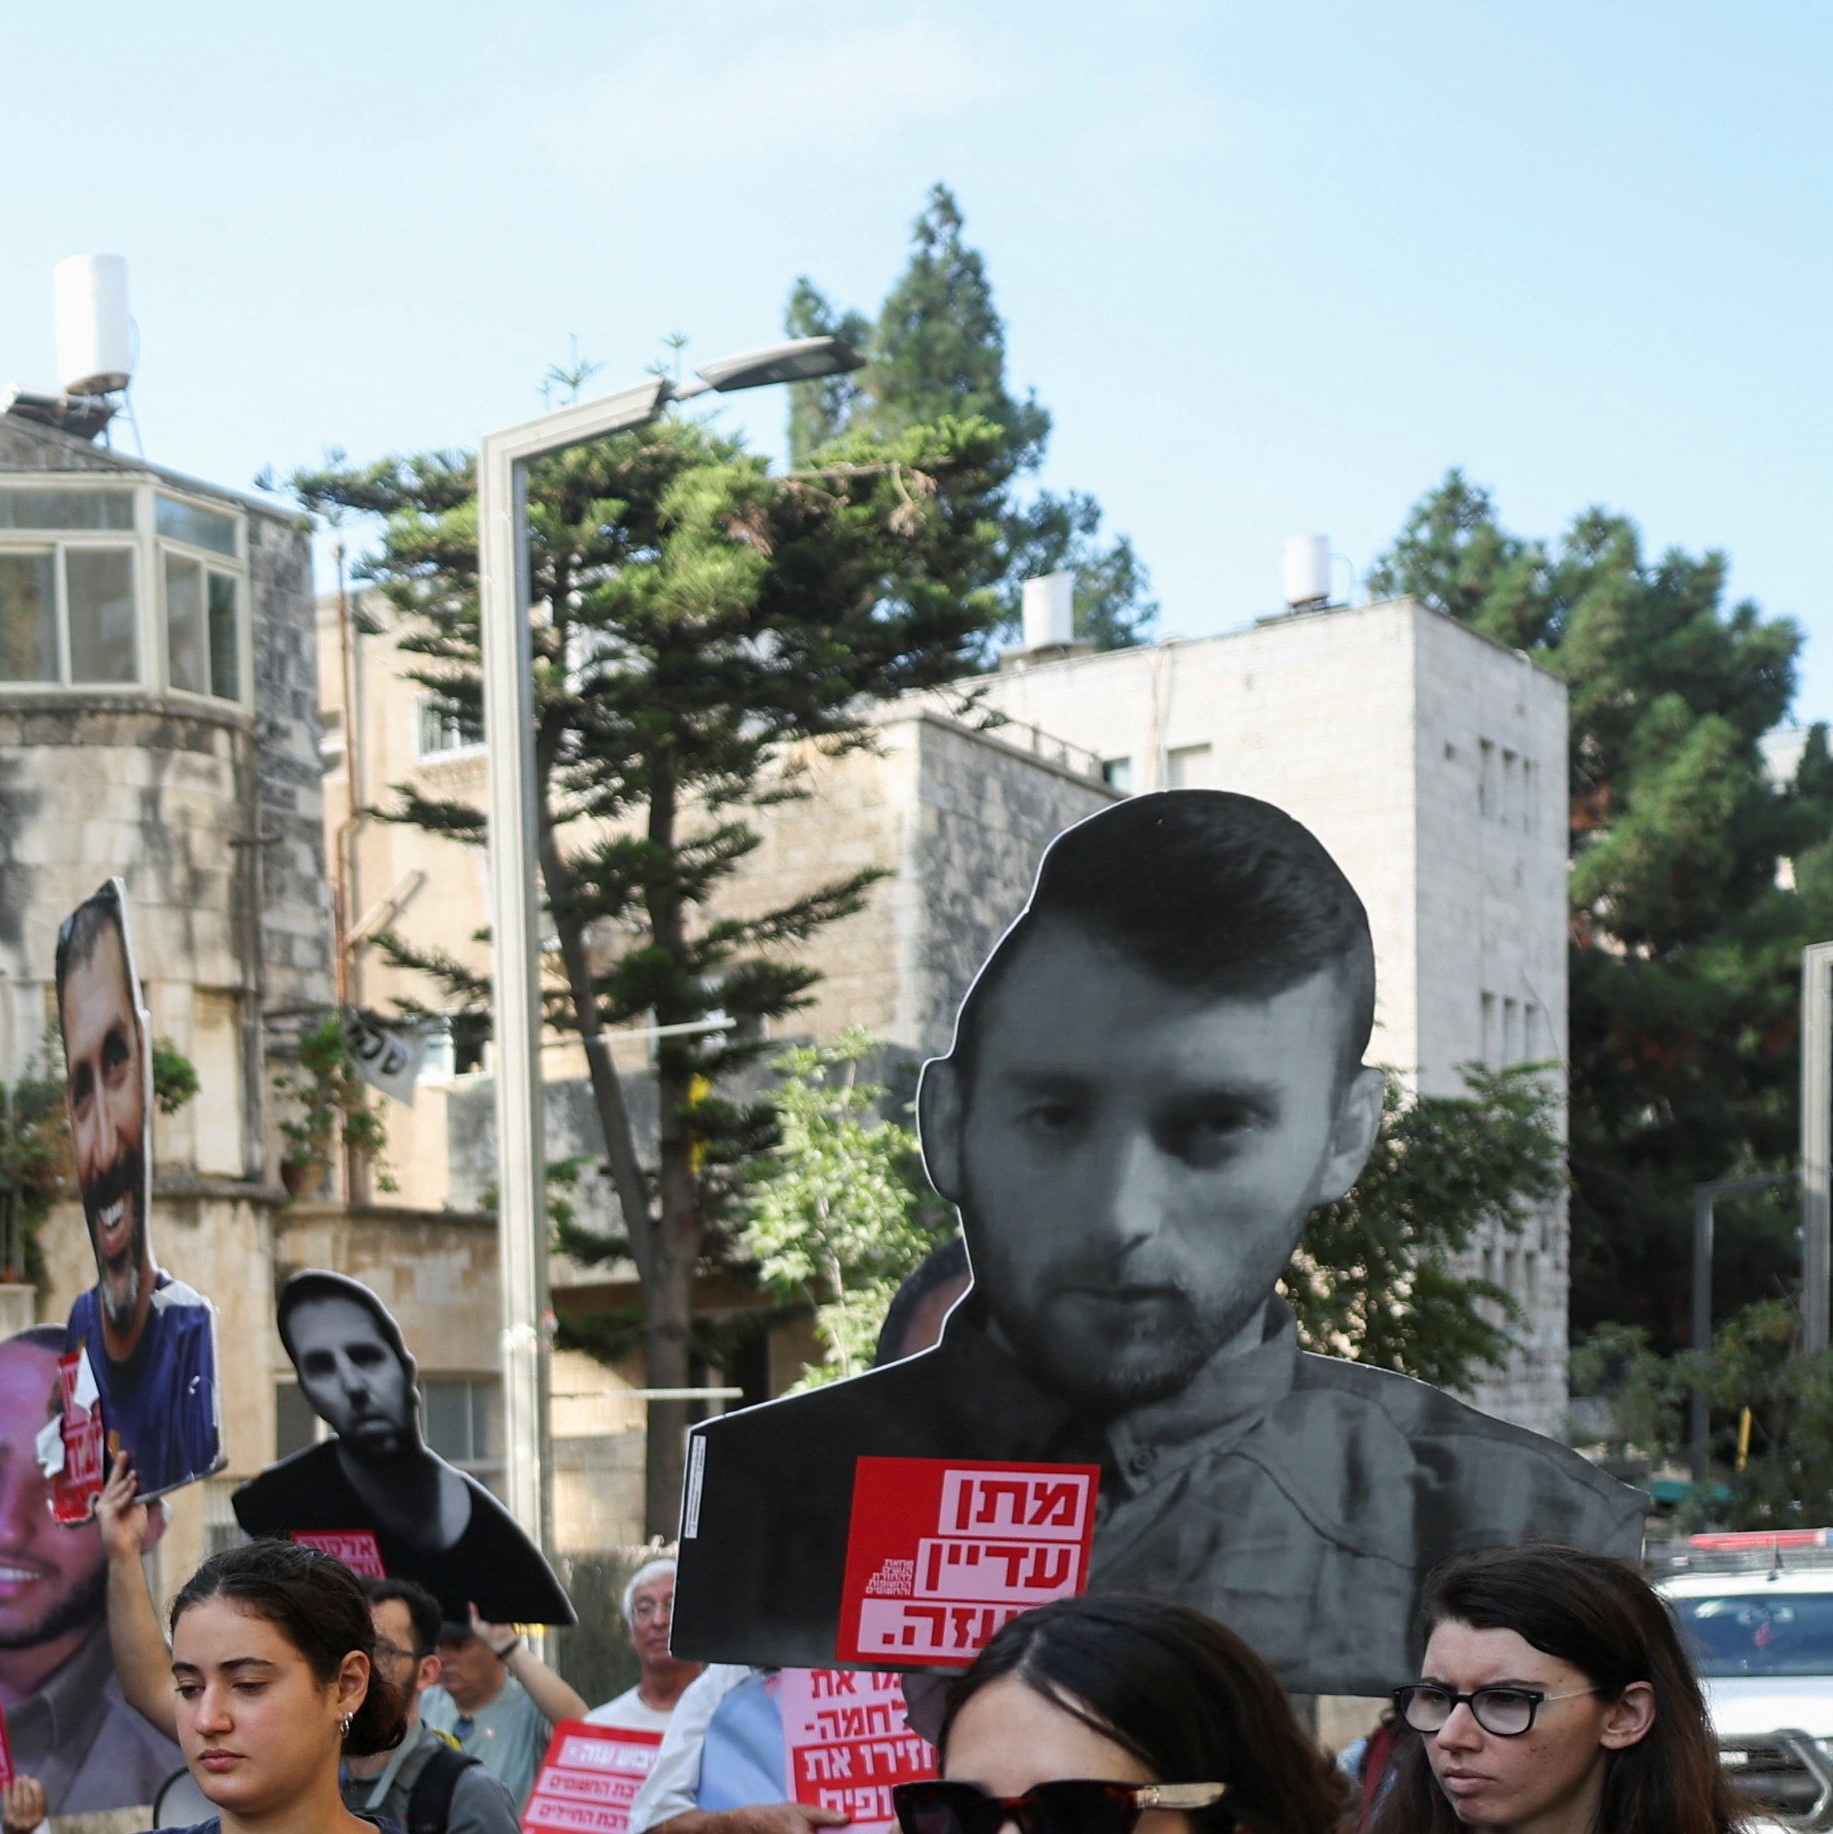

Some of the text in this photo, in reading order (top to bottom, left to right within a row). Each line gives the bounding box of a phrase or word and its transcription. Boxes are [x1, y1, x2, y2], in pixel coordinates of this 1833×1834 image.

[955, 1478, 1081, 1530] מתן
[925, 1542, 1072, 1592] עדיין
[882, 1605, 1018, 1650] עזה.
[804, 1746, 853, 1782] את
